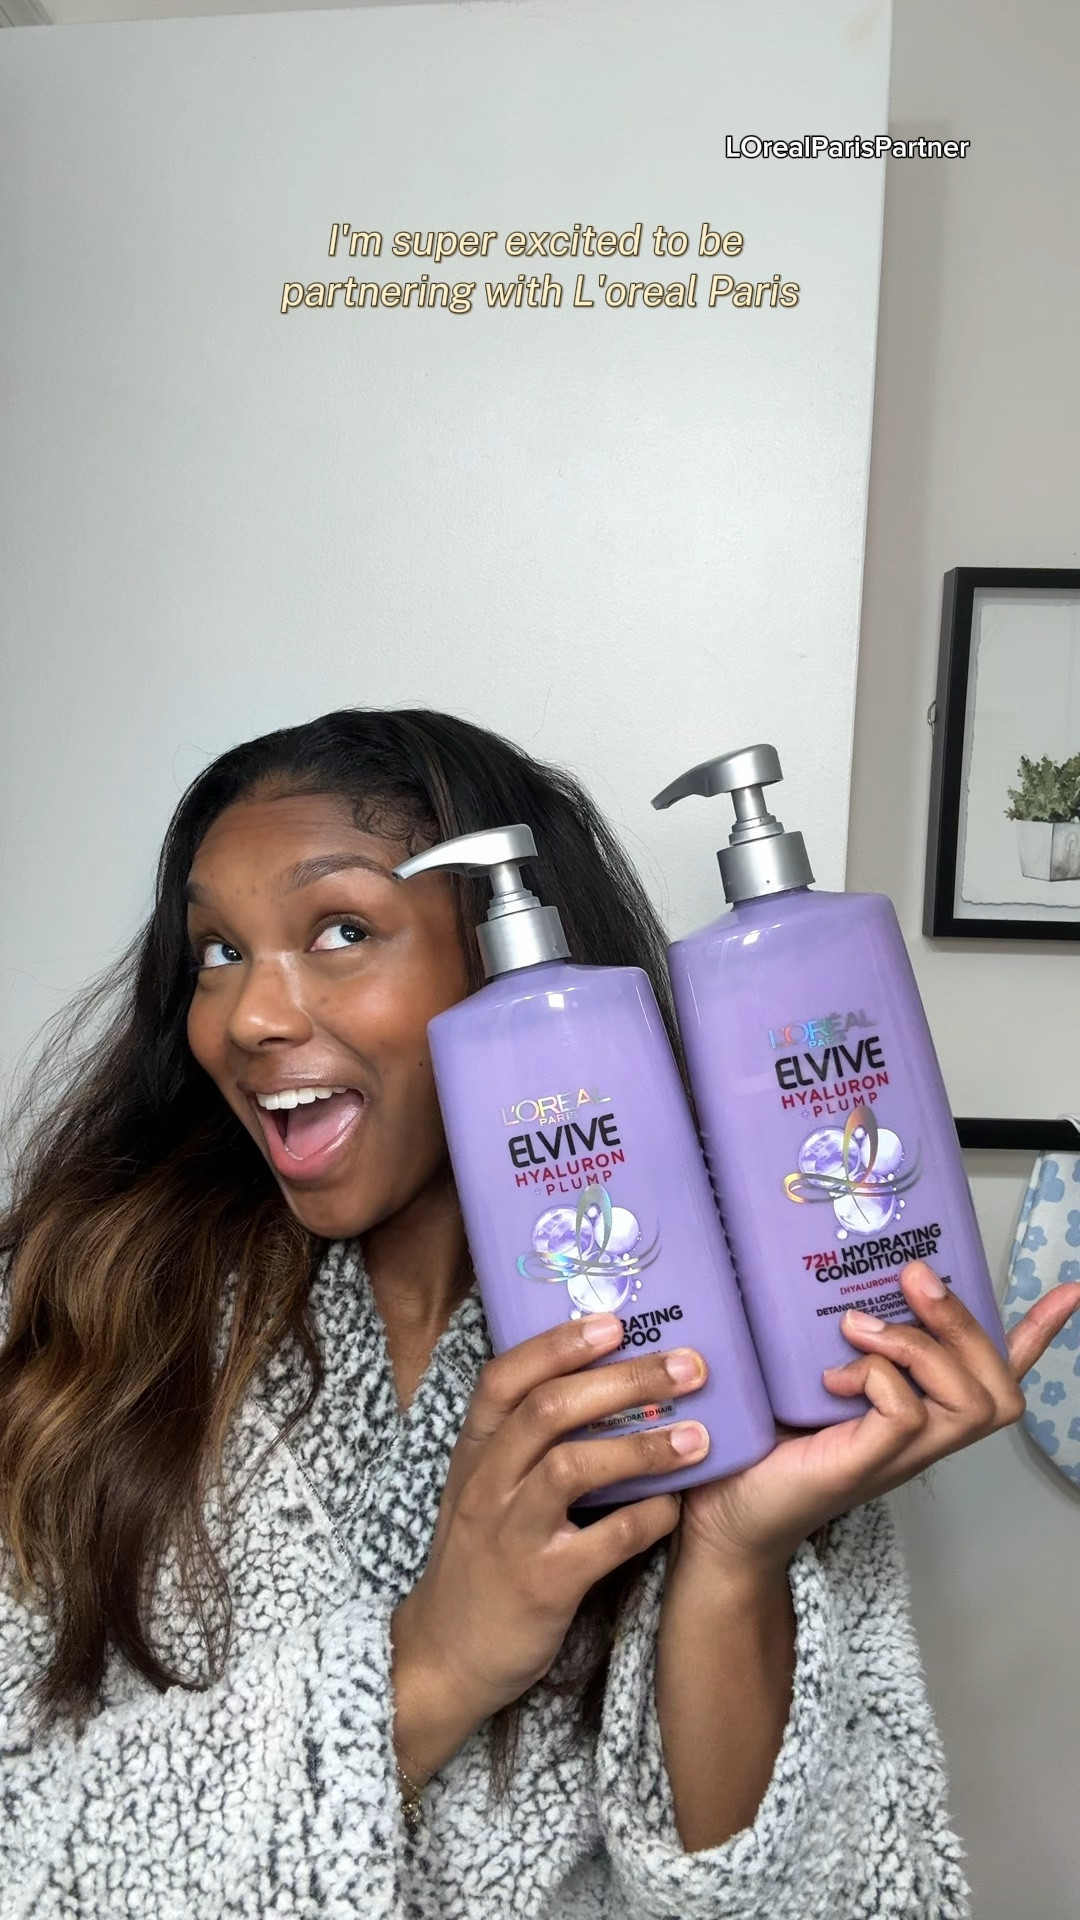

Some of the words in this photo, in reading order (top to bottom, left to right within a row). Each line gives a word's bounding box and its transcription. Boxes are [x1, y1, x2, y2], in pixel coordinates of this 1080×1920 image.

[775, 1036, 885, 1090] ELVIVE
[781, 1071, 889, 1109] HYALURON
[813, 1092, 878, 1117] PLUMP
[540, 1110, 578, 1126] PARIS
[508, 1113, 621, 1168] ELVIVE
[515, 1149, 625, 1187] HYALURON
[546, 1170, 612, 1196] PLUMP
[801, 1250, 838, 1271] 72H
[841, 1223, 942, 1262] HYDRATING
[815, 1240, 939, 1283] CONDITIONER
[608, 1410, 655, 1426] DEHYDRATED
[655, 1405, 672, 1415] HAIR
